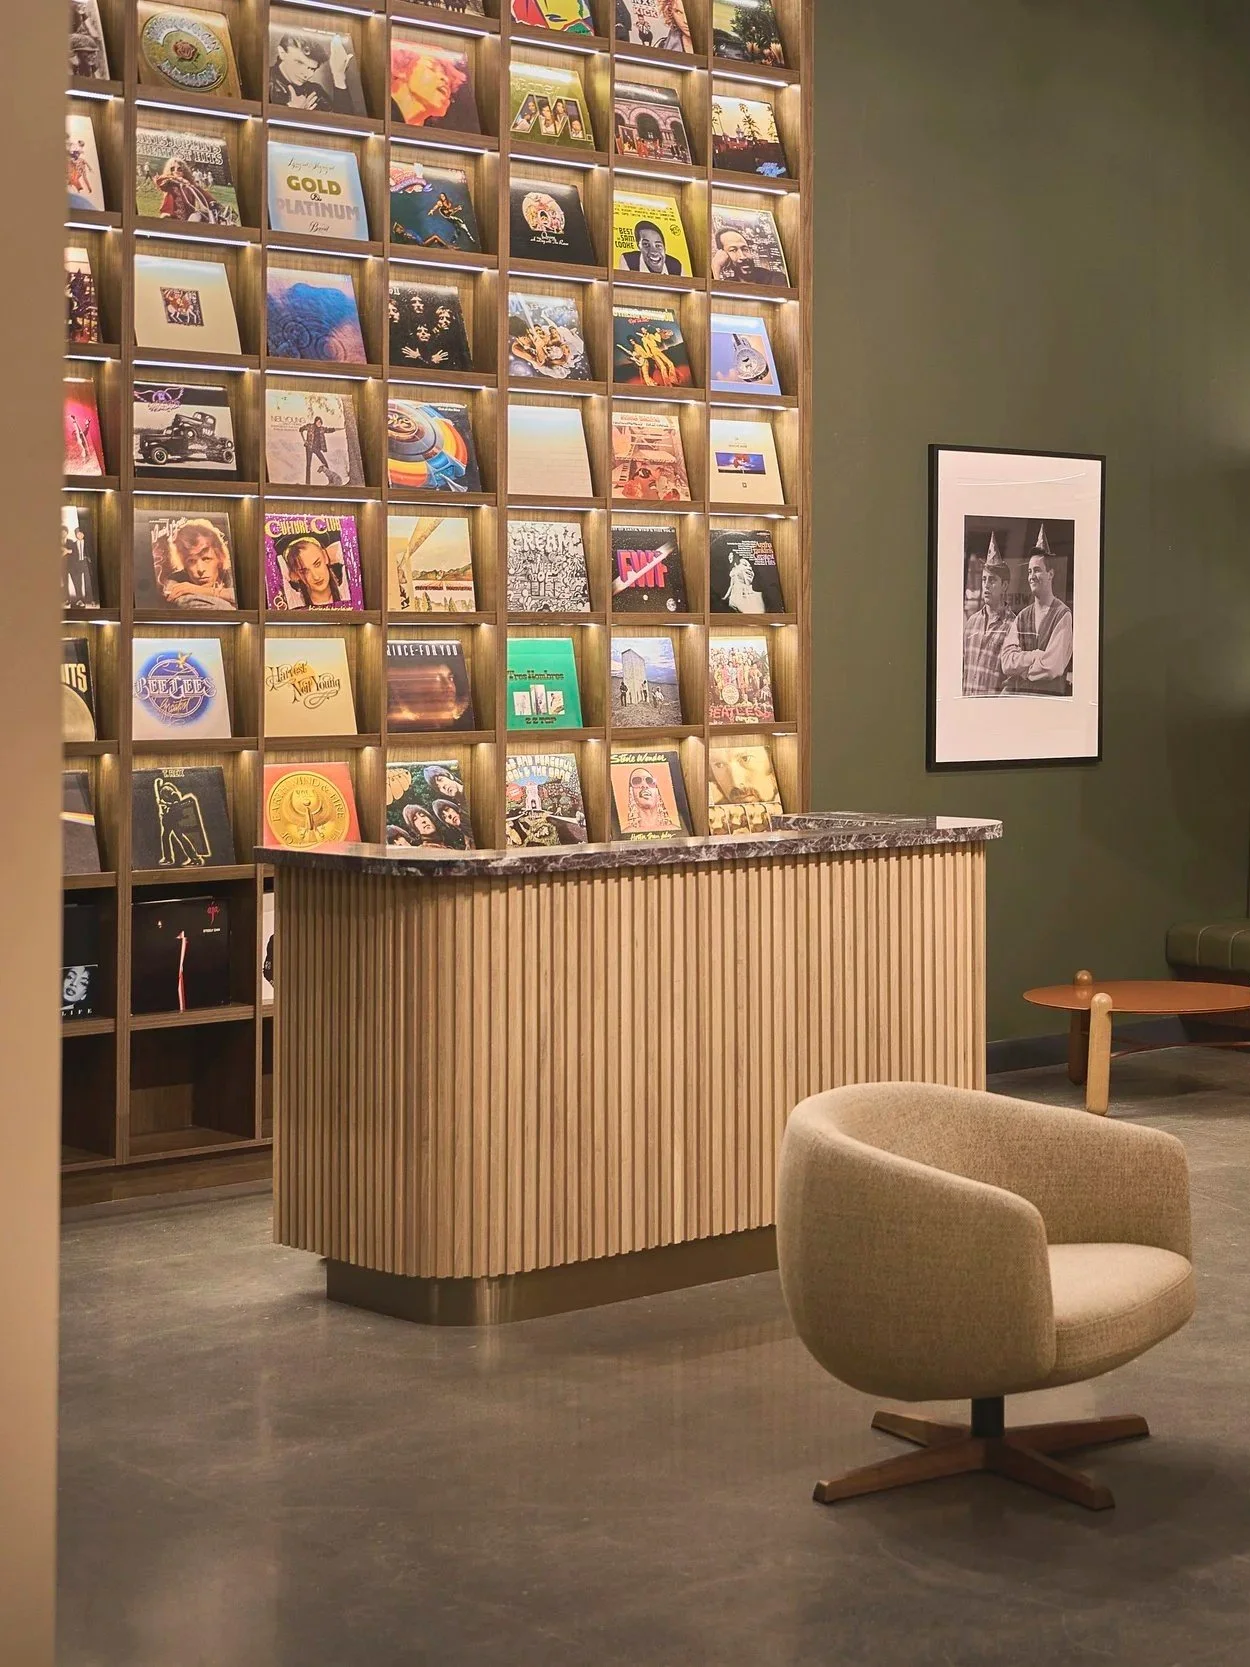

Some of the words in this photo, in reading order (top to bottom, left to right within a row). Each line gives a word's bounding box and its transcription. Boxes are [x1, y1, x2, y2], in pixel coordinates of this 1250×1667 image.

[633, 7, 659, 18] KICK
[192, 149, 224, 166] HITS
[286, 175, 342, 196] GOLD
[275, 197, 361, 222] PLATINUM
[618, 226, 633, 236] BEST
[614, 240, 635, 250] COOKE
[264, 519, 310, 539] CULTURE
[310, 516, 342, 535] CLUB
[439, 644, 459, 656] YOU
[60, 663, 88, 693] ITS
[308, 672, 341, 705] Young
[636, 752, 667, 763] Wonder
[329, 792, 346, 820] FIRE
